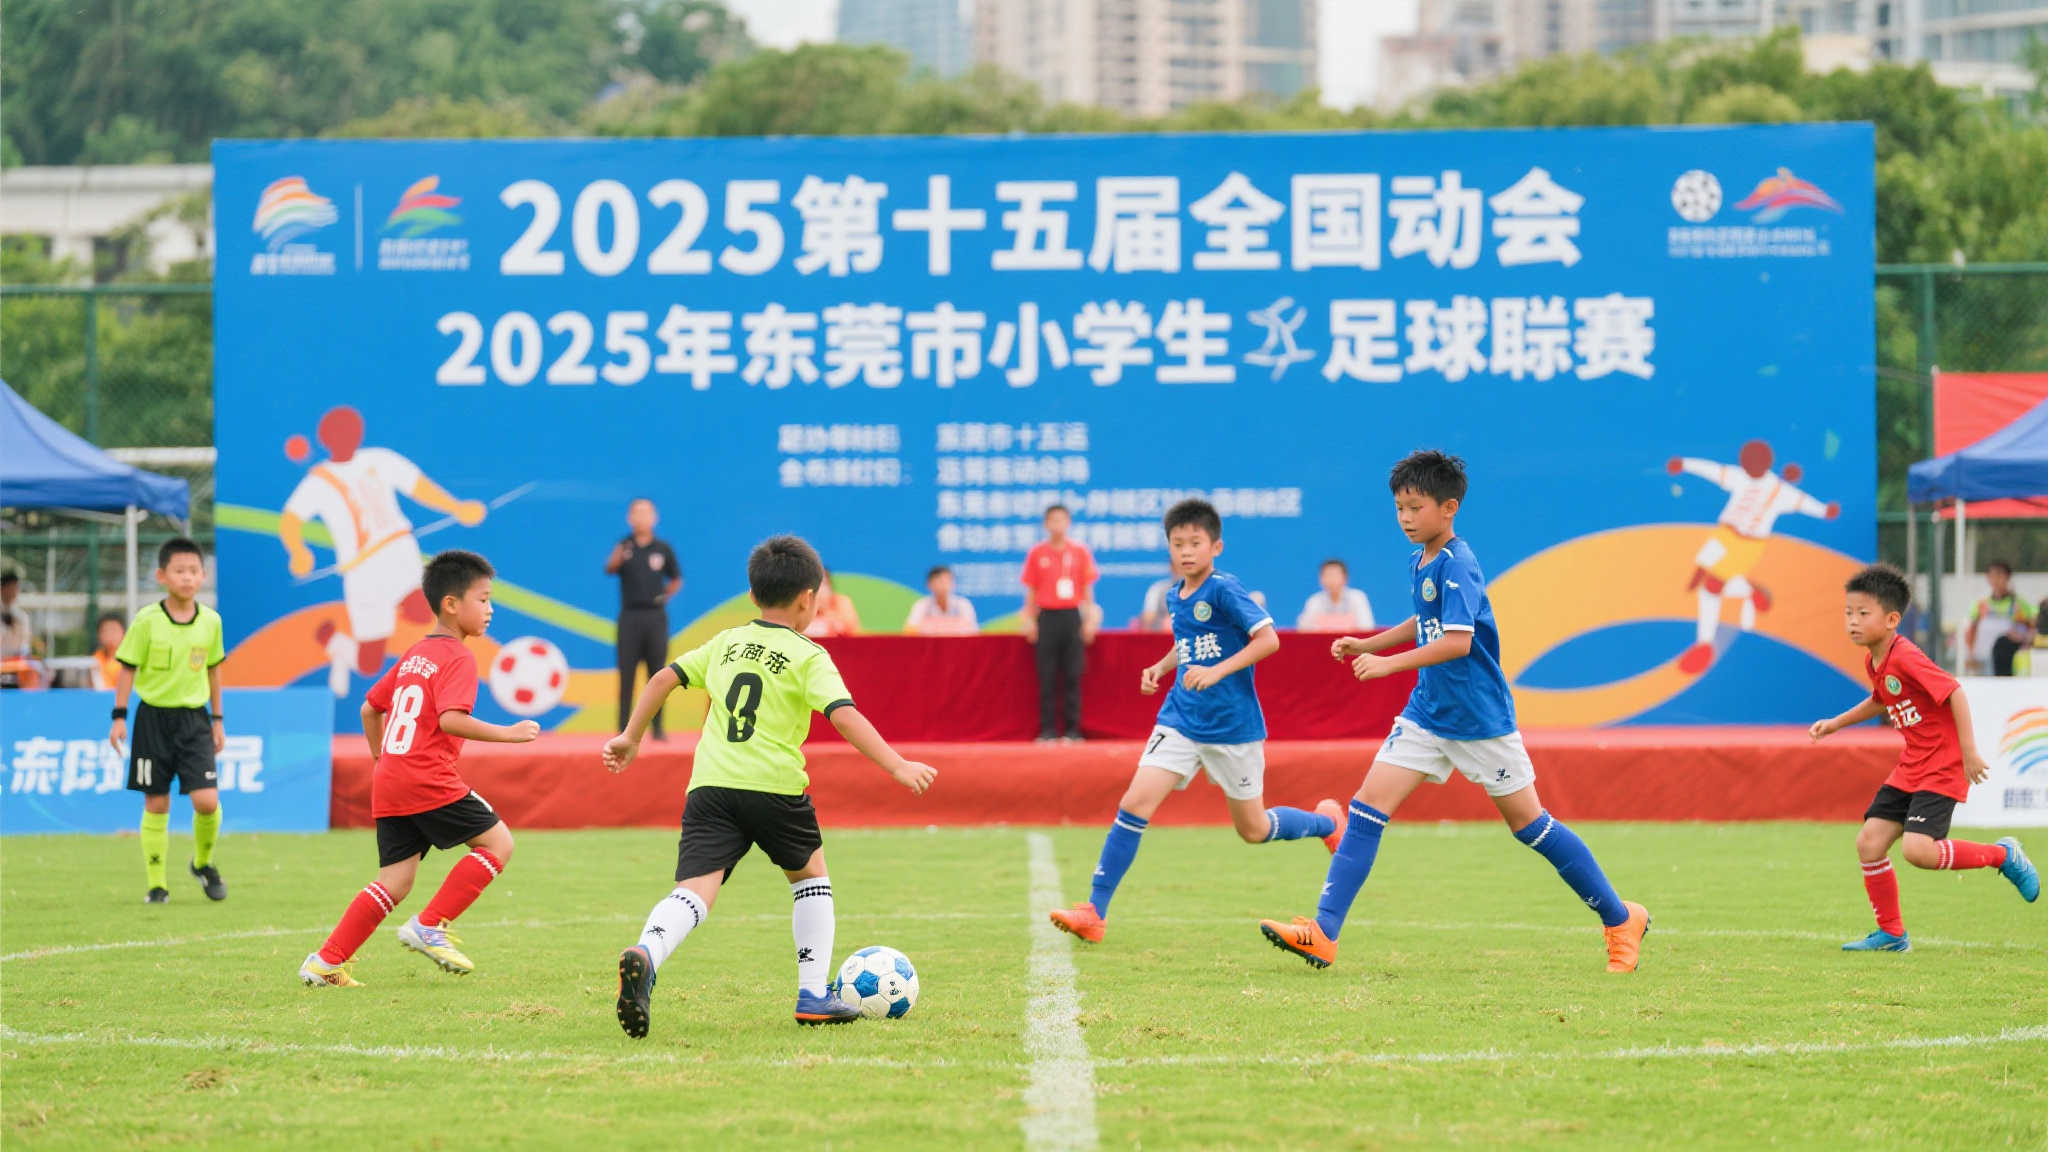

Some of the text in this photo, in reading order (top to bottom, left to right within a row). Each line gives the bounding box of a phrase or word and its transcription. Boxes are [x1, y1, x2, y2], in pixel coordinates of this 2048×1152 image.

[501, 168, 1585, 277] 2025第十五届全国动会
[436, 299, 1236, 390] 2025年东莞市小学生
